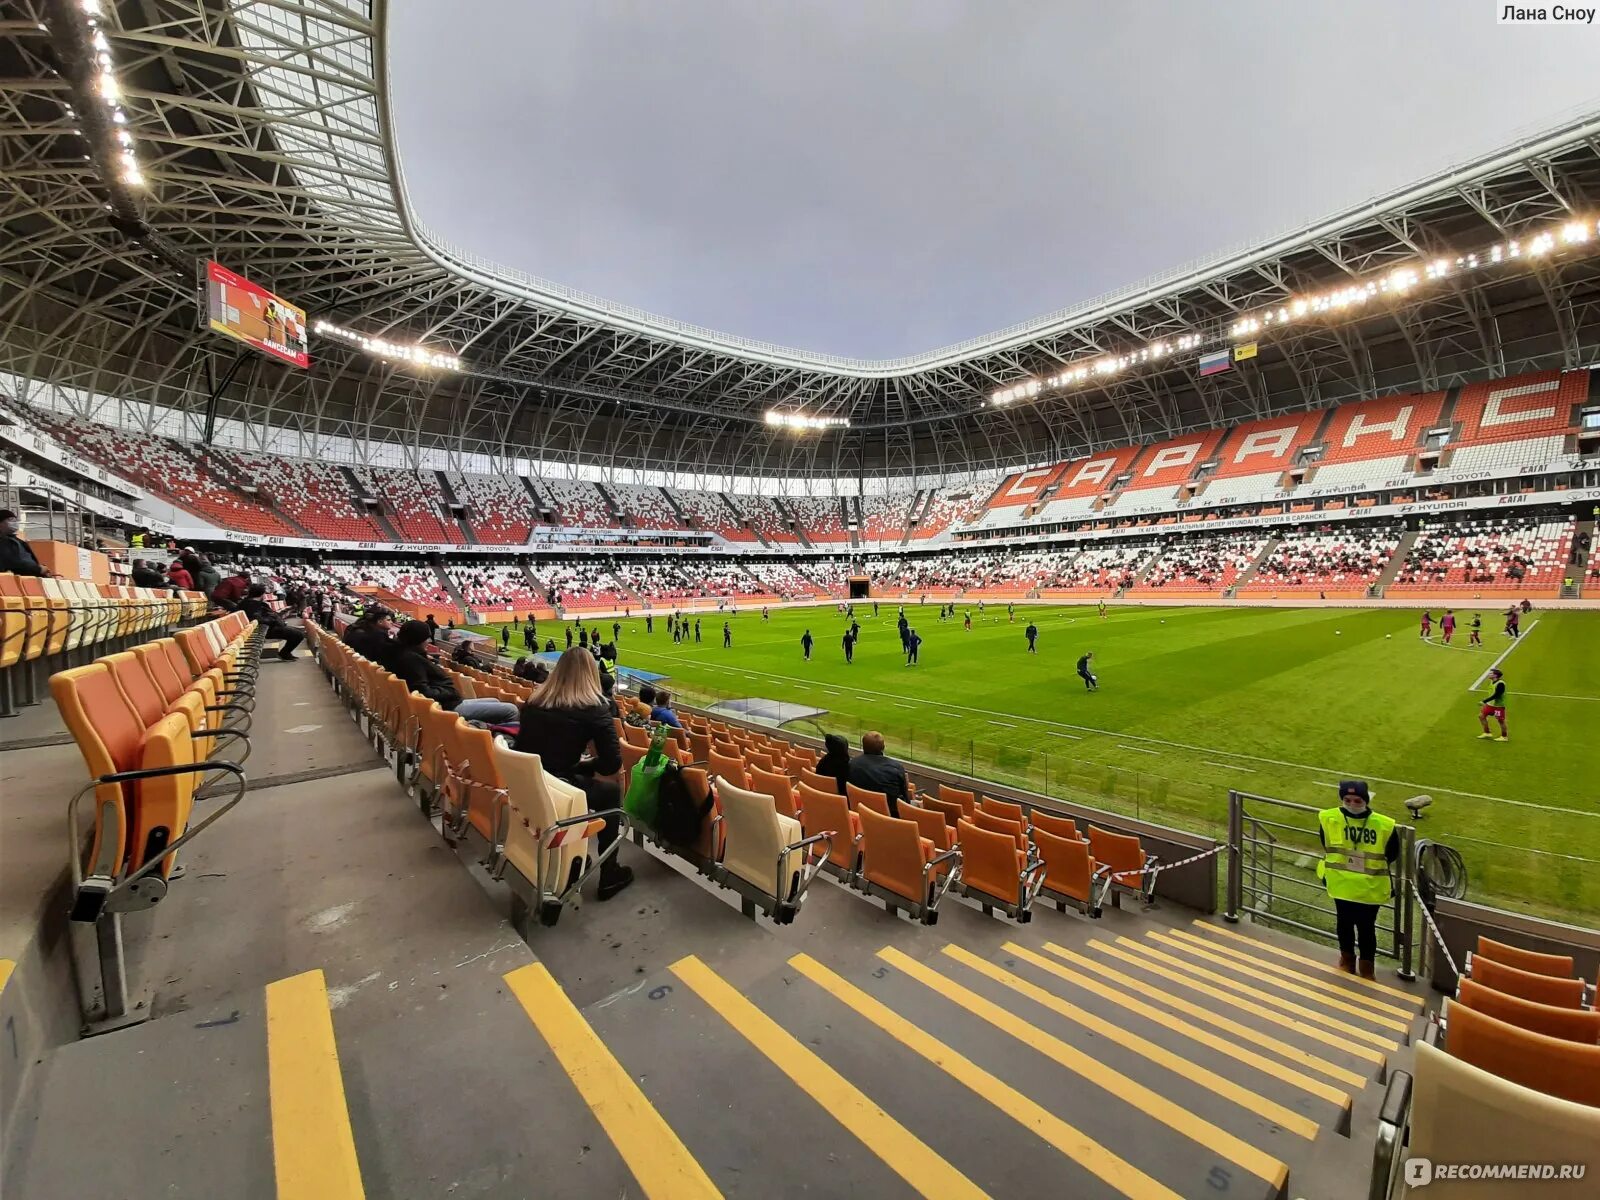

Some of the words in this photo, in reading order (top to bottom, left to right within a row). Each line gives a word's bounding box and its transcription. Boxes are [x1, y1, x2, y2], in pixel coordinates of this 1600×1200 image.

[1450, 471, 1492, 481] TOYOTA
[1418, 501, 1468, 511] HYUNDAI
[1206, 521, 1226, 529] ДИЛЕР
[1227, 518, 1254, 527] HYUNDAI
[1260, 516, 1285, 525] TOYOTA
[1292, 513, 1327, 522] САРАНСКЕ
[1344, 825, 1377, 845] 10789
